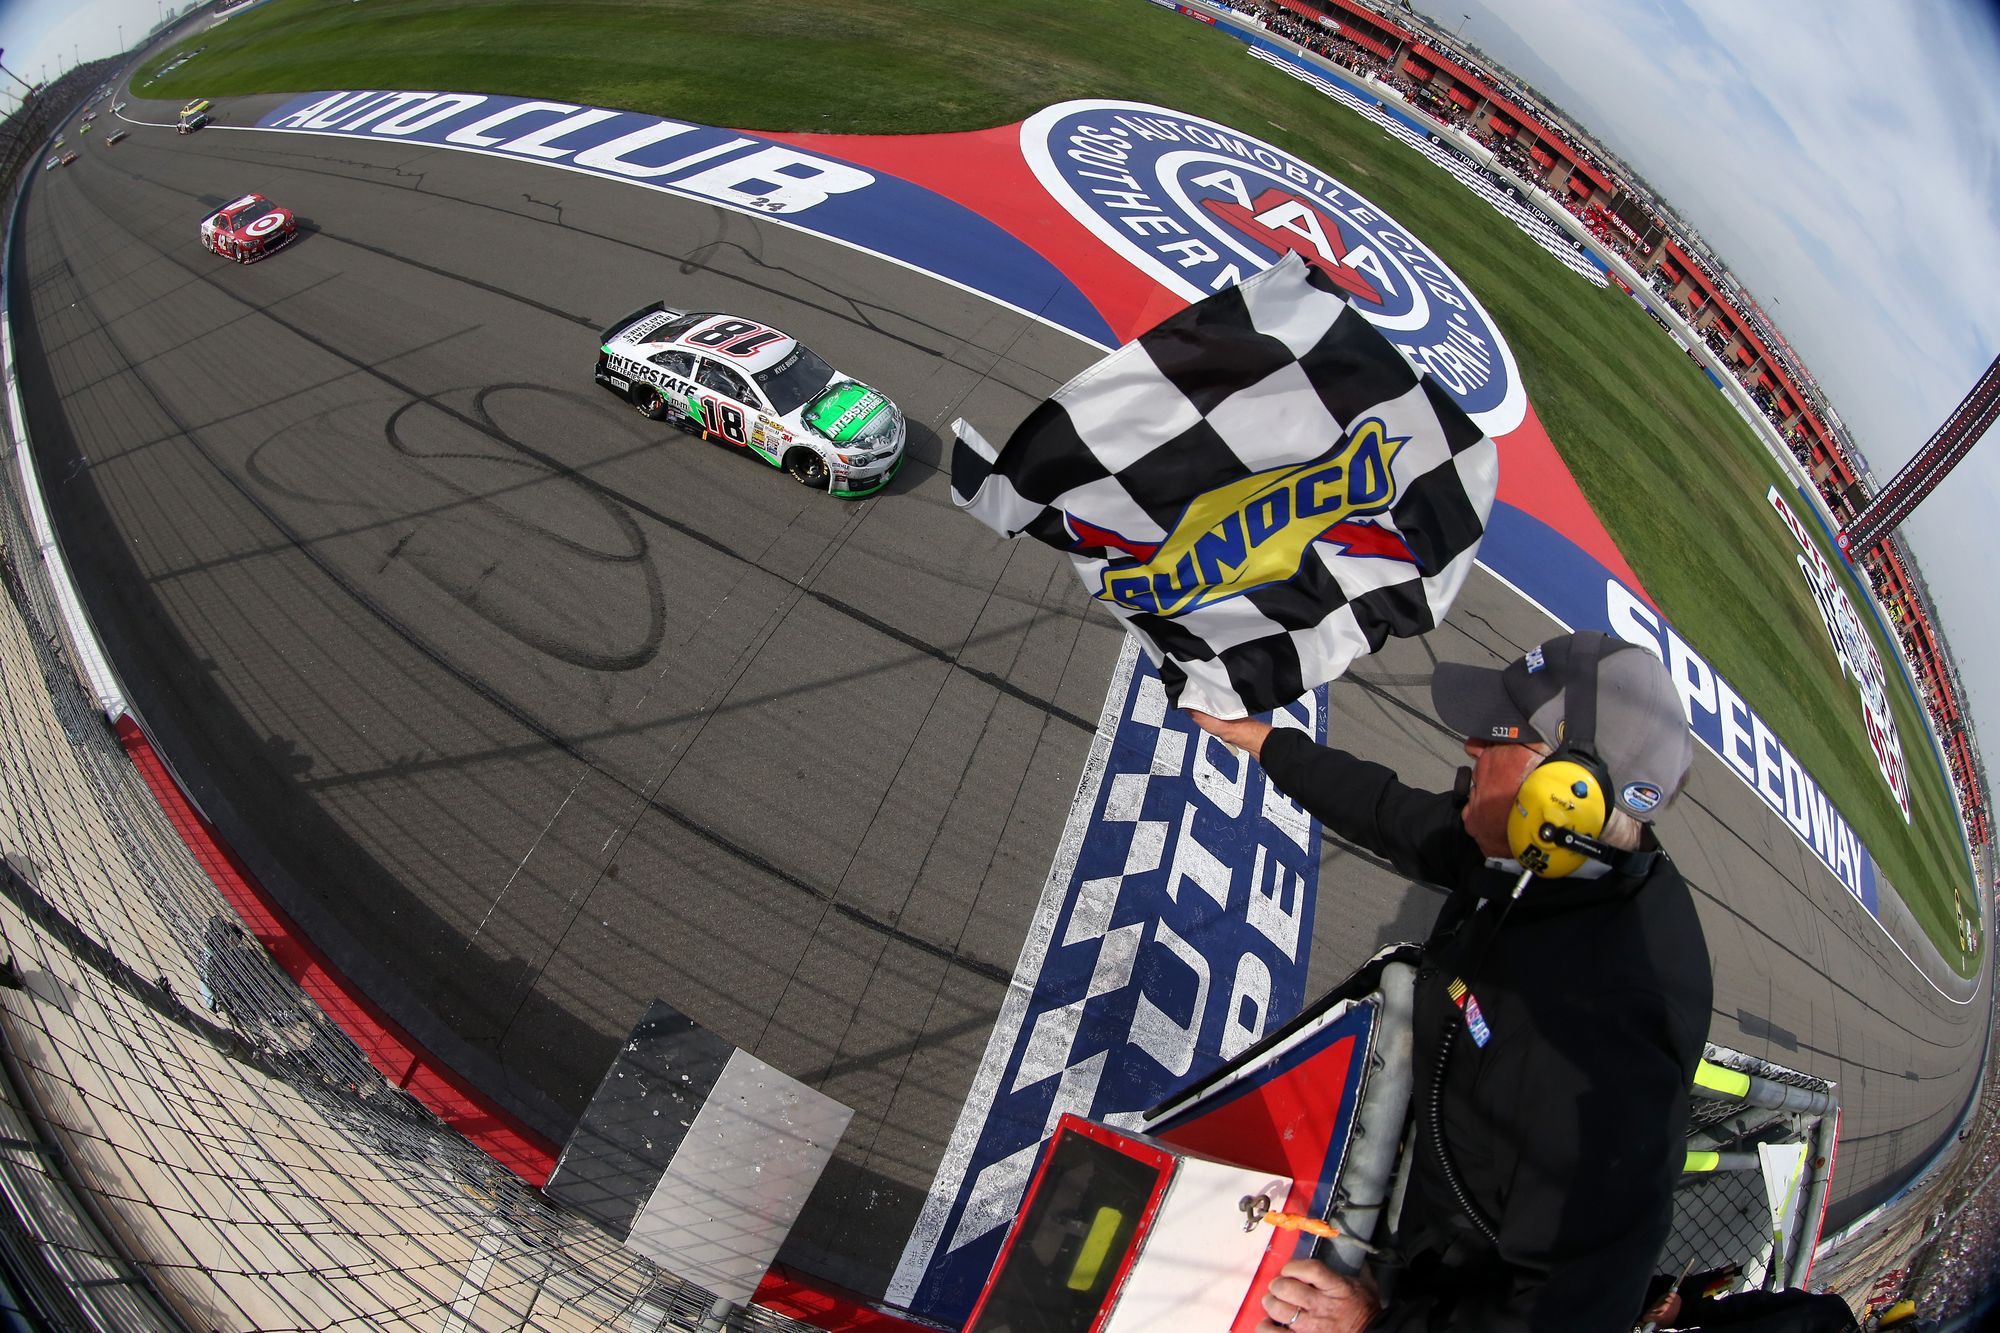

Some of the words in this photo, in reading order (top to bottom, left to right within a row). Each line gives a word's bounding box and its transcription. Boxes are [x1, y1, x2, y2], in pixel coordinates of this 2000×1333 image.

[270, 91, 488, 135] AUTO
[444, 101, 876, 213] CLUB
[750, 197, 787, 212] 24
[1114, 116, 1386, 224] AUTOMOBILE
[1377, 230, 1462, 313] CLUB
[1190, 169, 1400, 298] AAA
[685, 320, 787, 357] 18
[609, 352, 698, 398] INTERSTATE
[773, 363, 787, 375] KYLE
[785, 354, 799, 368] BUSCH
[700, 395, 748, 447] 18
[781, 433, 793, 443] 3M
[826, 391, 878, 439] INTERSTATE
[1111, 431, 1389, 612] SUNOCO
[1607, 578, 1863, 899] SPEEDWAY
